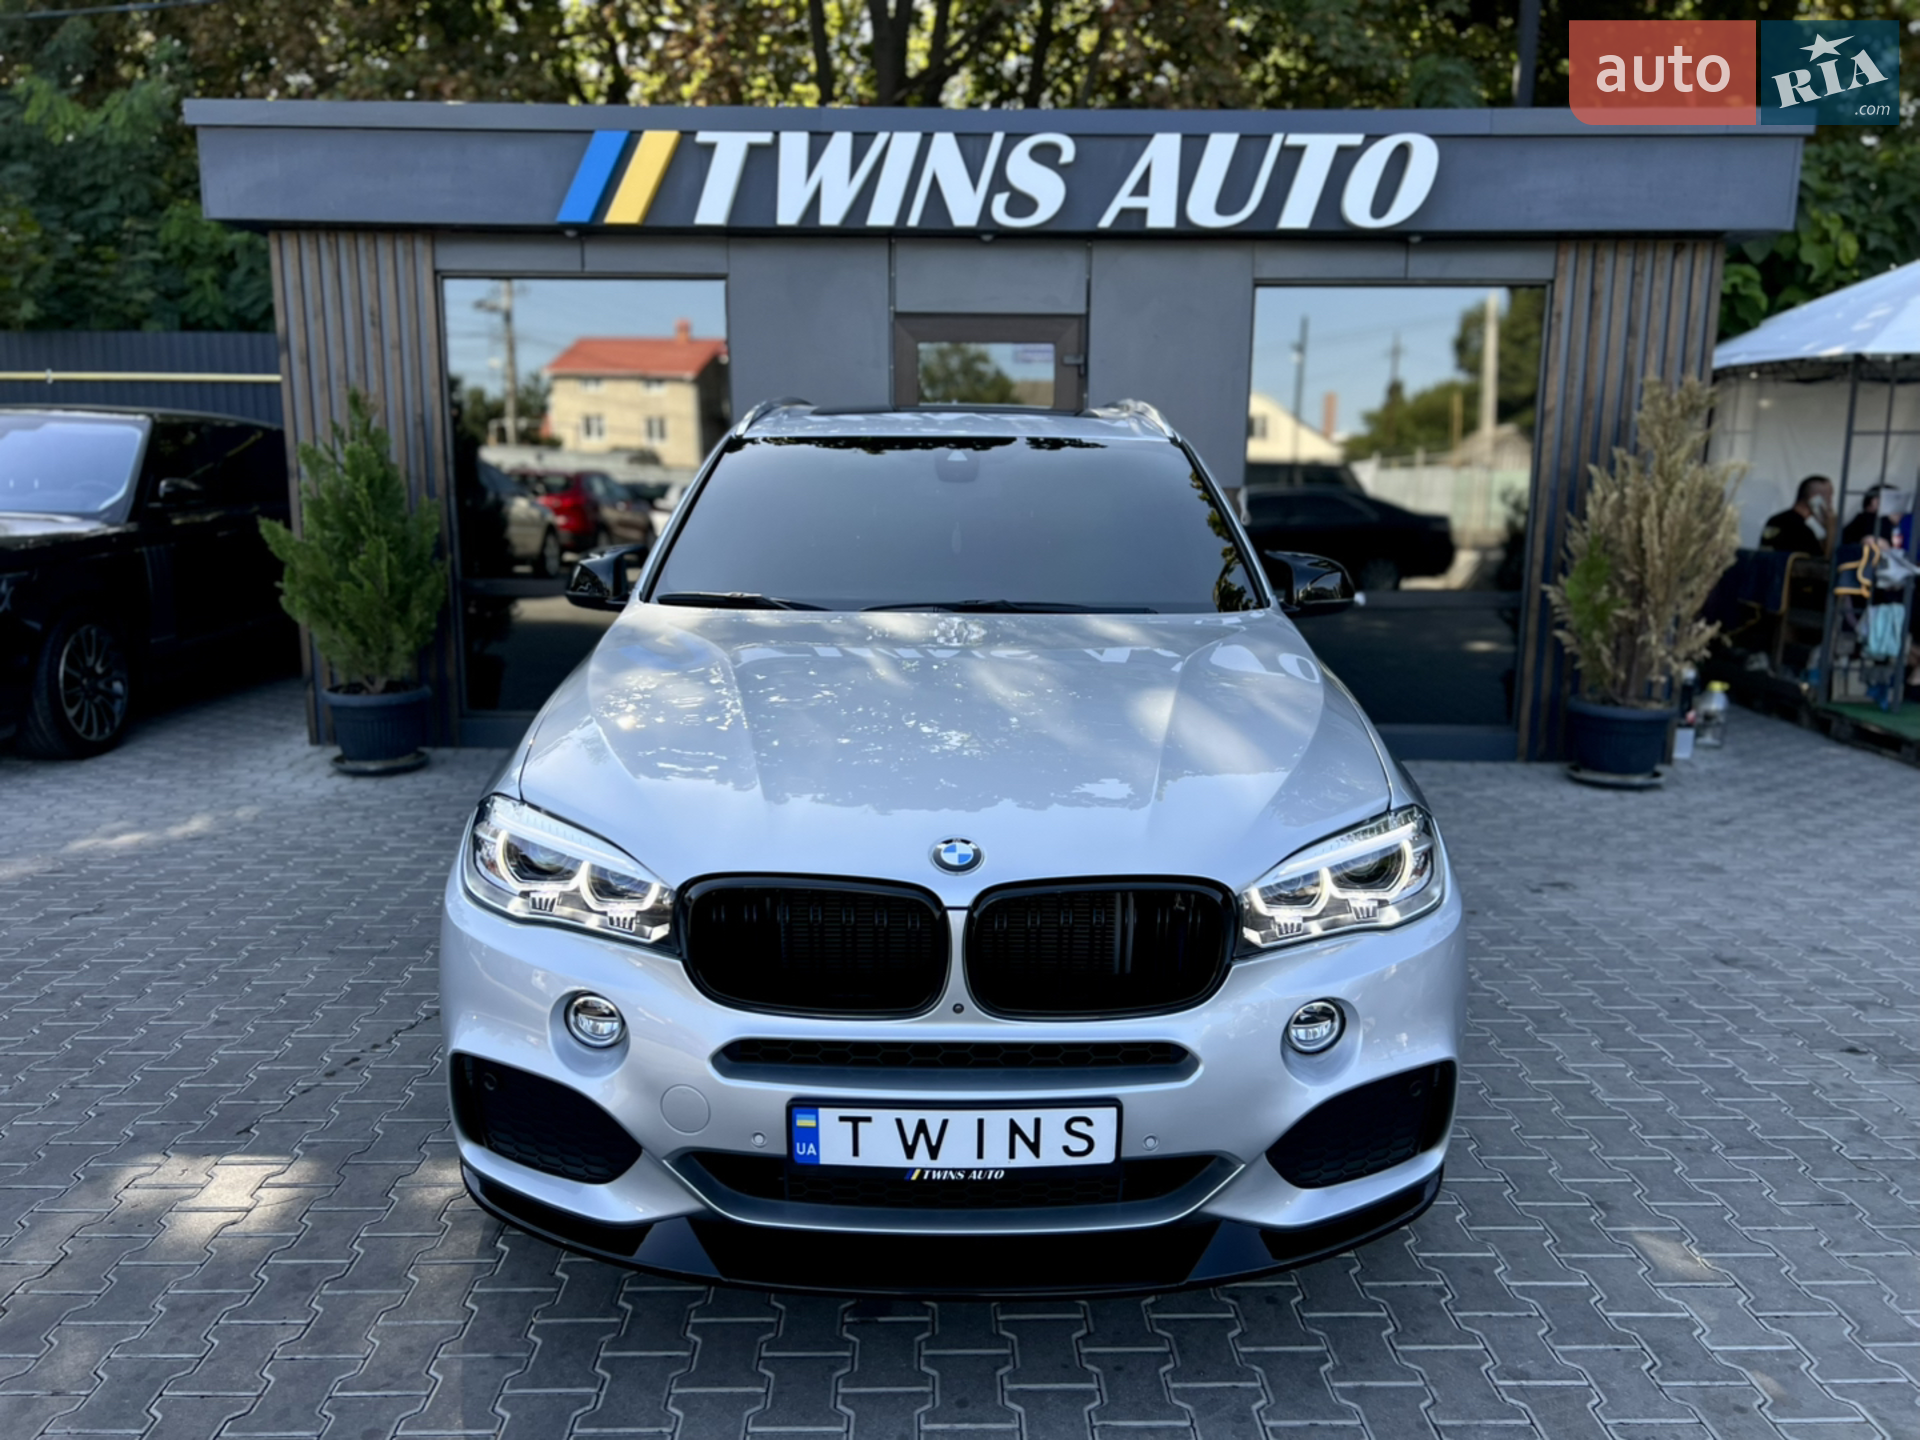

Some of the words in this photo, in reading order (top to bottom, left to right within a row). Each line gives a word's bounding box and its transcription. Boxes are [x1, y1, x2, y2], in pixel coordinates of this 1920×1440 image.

[693, 130, 1075, 230] TWINS
[1097, 132, 1440, 230] AUTO
[796, 1141, 817, 1156] UA
[922, 1169, 965, 1181] TWINS
[967, 1169, 1005, 1180] AUTO
